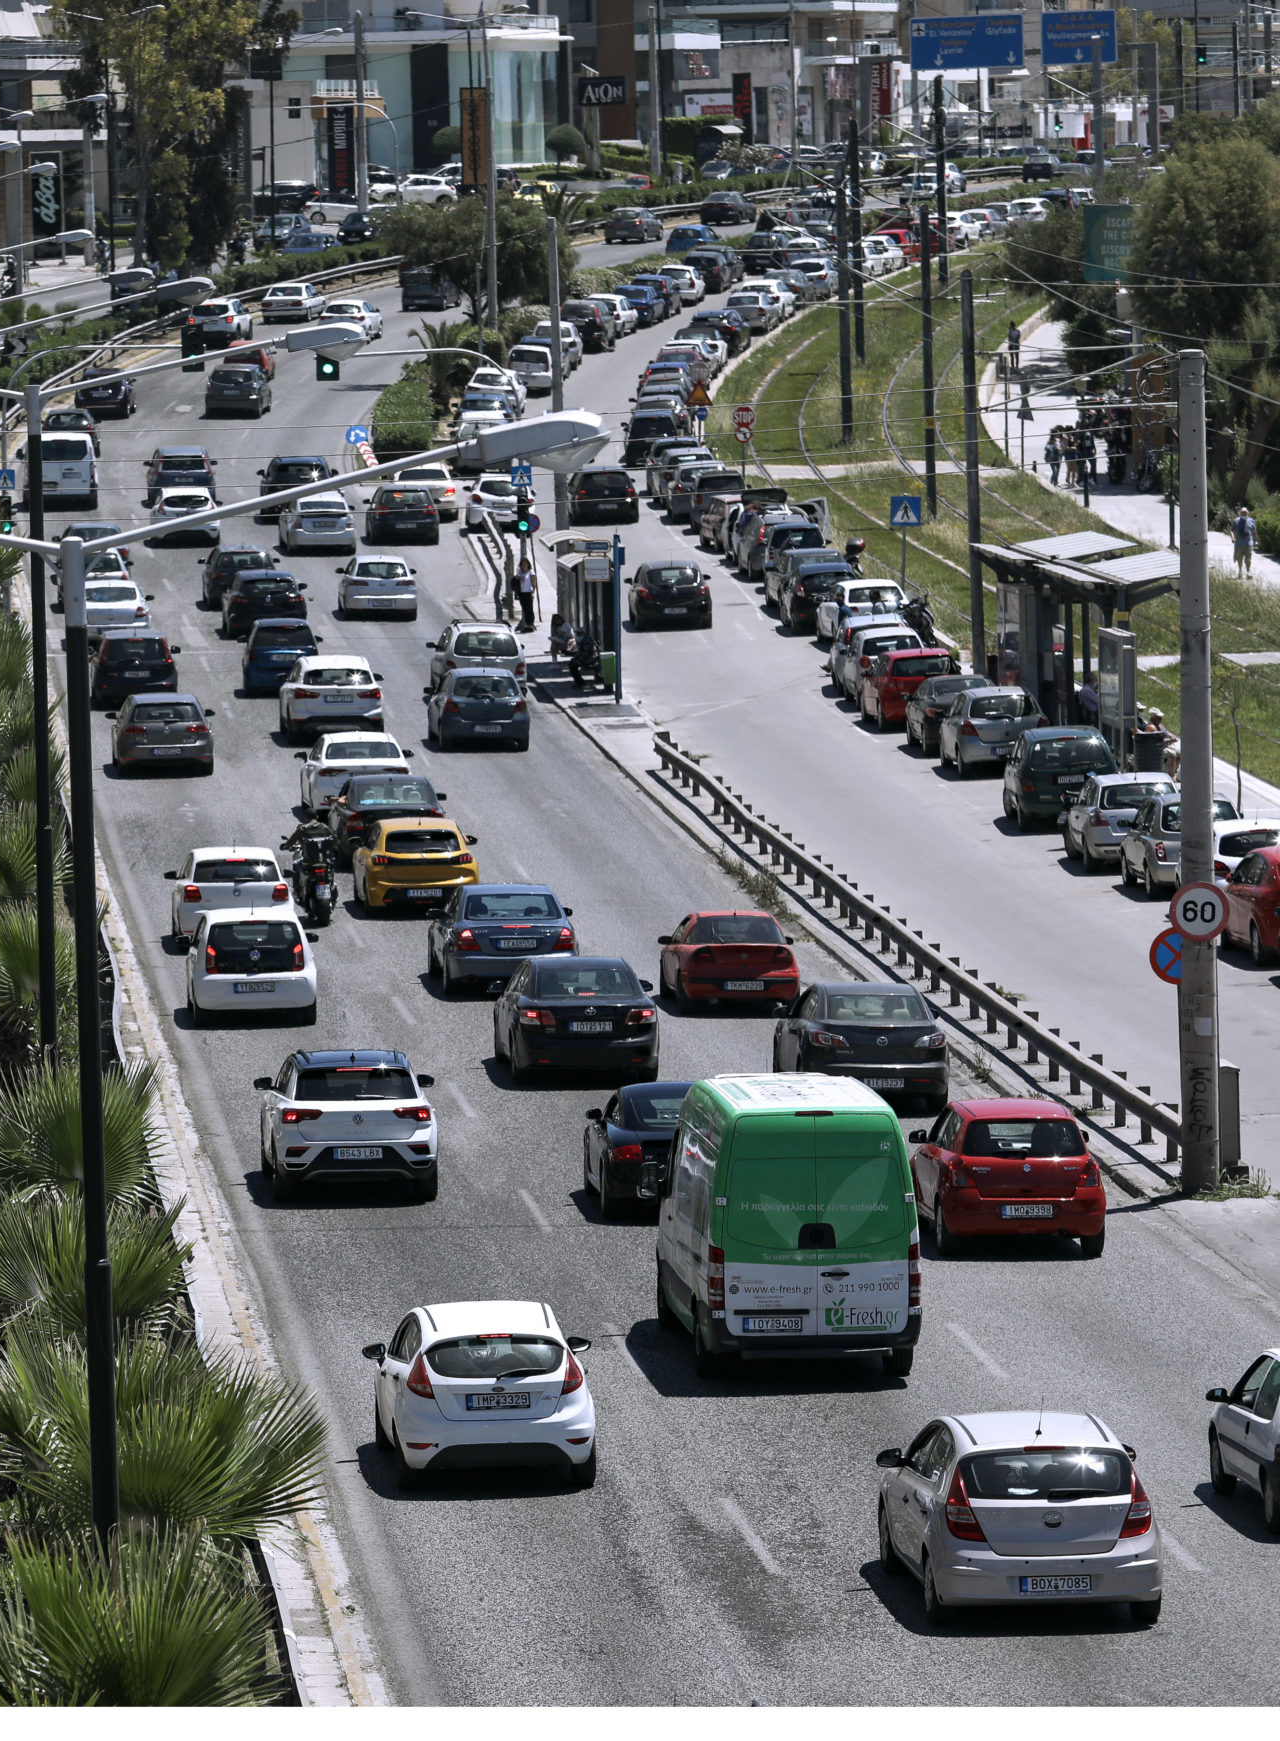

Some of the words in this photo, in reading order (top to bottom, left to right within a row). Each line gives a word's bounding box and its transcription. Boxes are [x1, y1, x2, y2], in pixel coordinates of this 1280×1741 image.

[333, 113, 347, 149] MOBILE
[1103, 230, 1119, 241] THE
[733, 411, 754, 423] STOP
[1182, 900, 1216, 923] 60
[337, 1148, 360, 1158] 8543
[362, 1147, 379, 1157] LBX
[752, 1202, 805, 1212] παραγγελία
[808, 1203, 825, 1212] σας
[850, 1202, 889, 1211] καθοδόν
[772, 1254, 790, 1262] super
[859, 1253, 872, 1261] σας
[744, 1284, 813, 1296] www.e-fresh.gr
[838, 1284, 855, 1293] 211
[858, 1283, 875, 1292] 990
[877, 1282, 900, 1291] 1000
